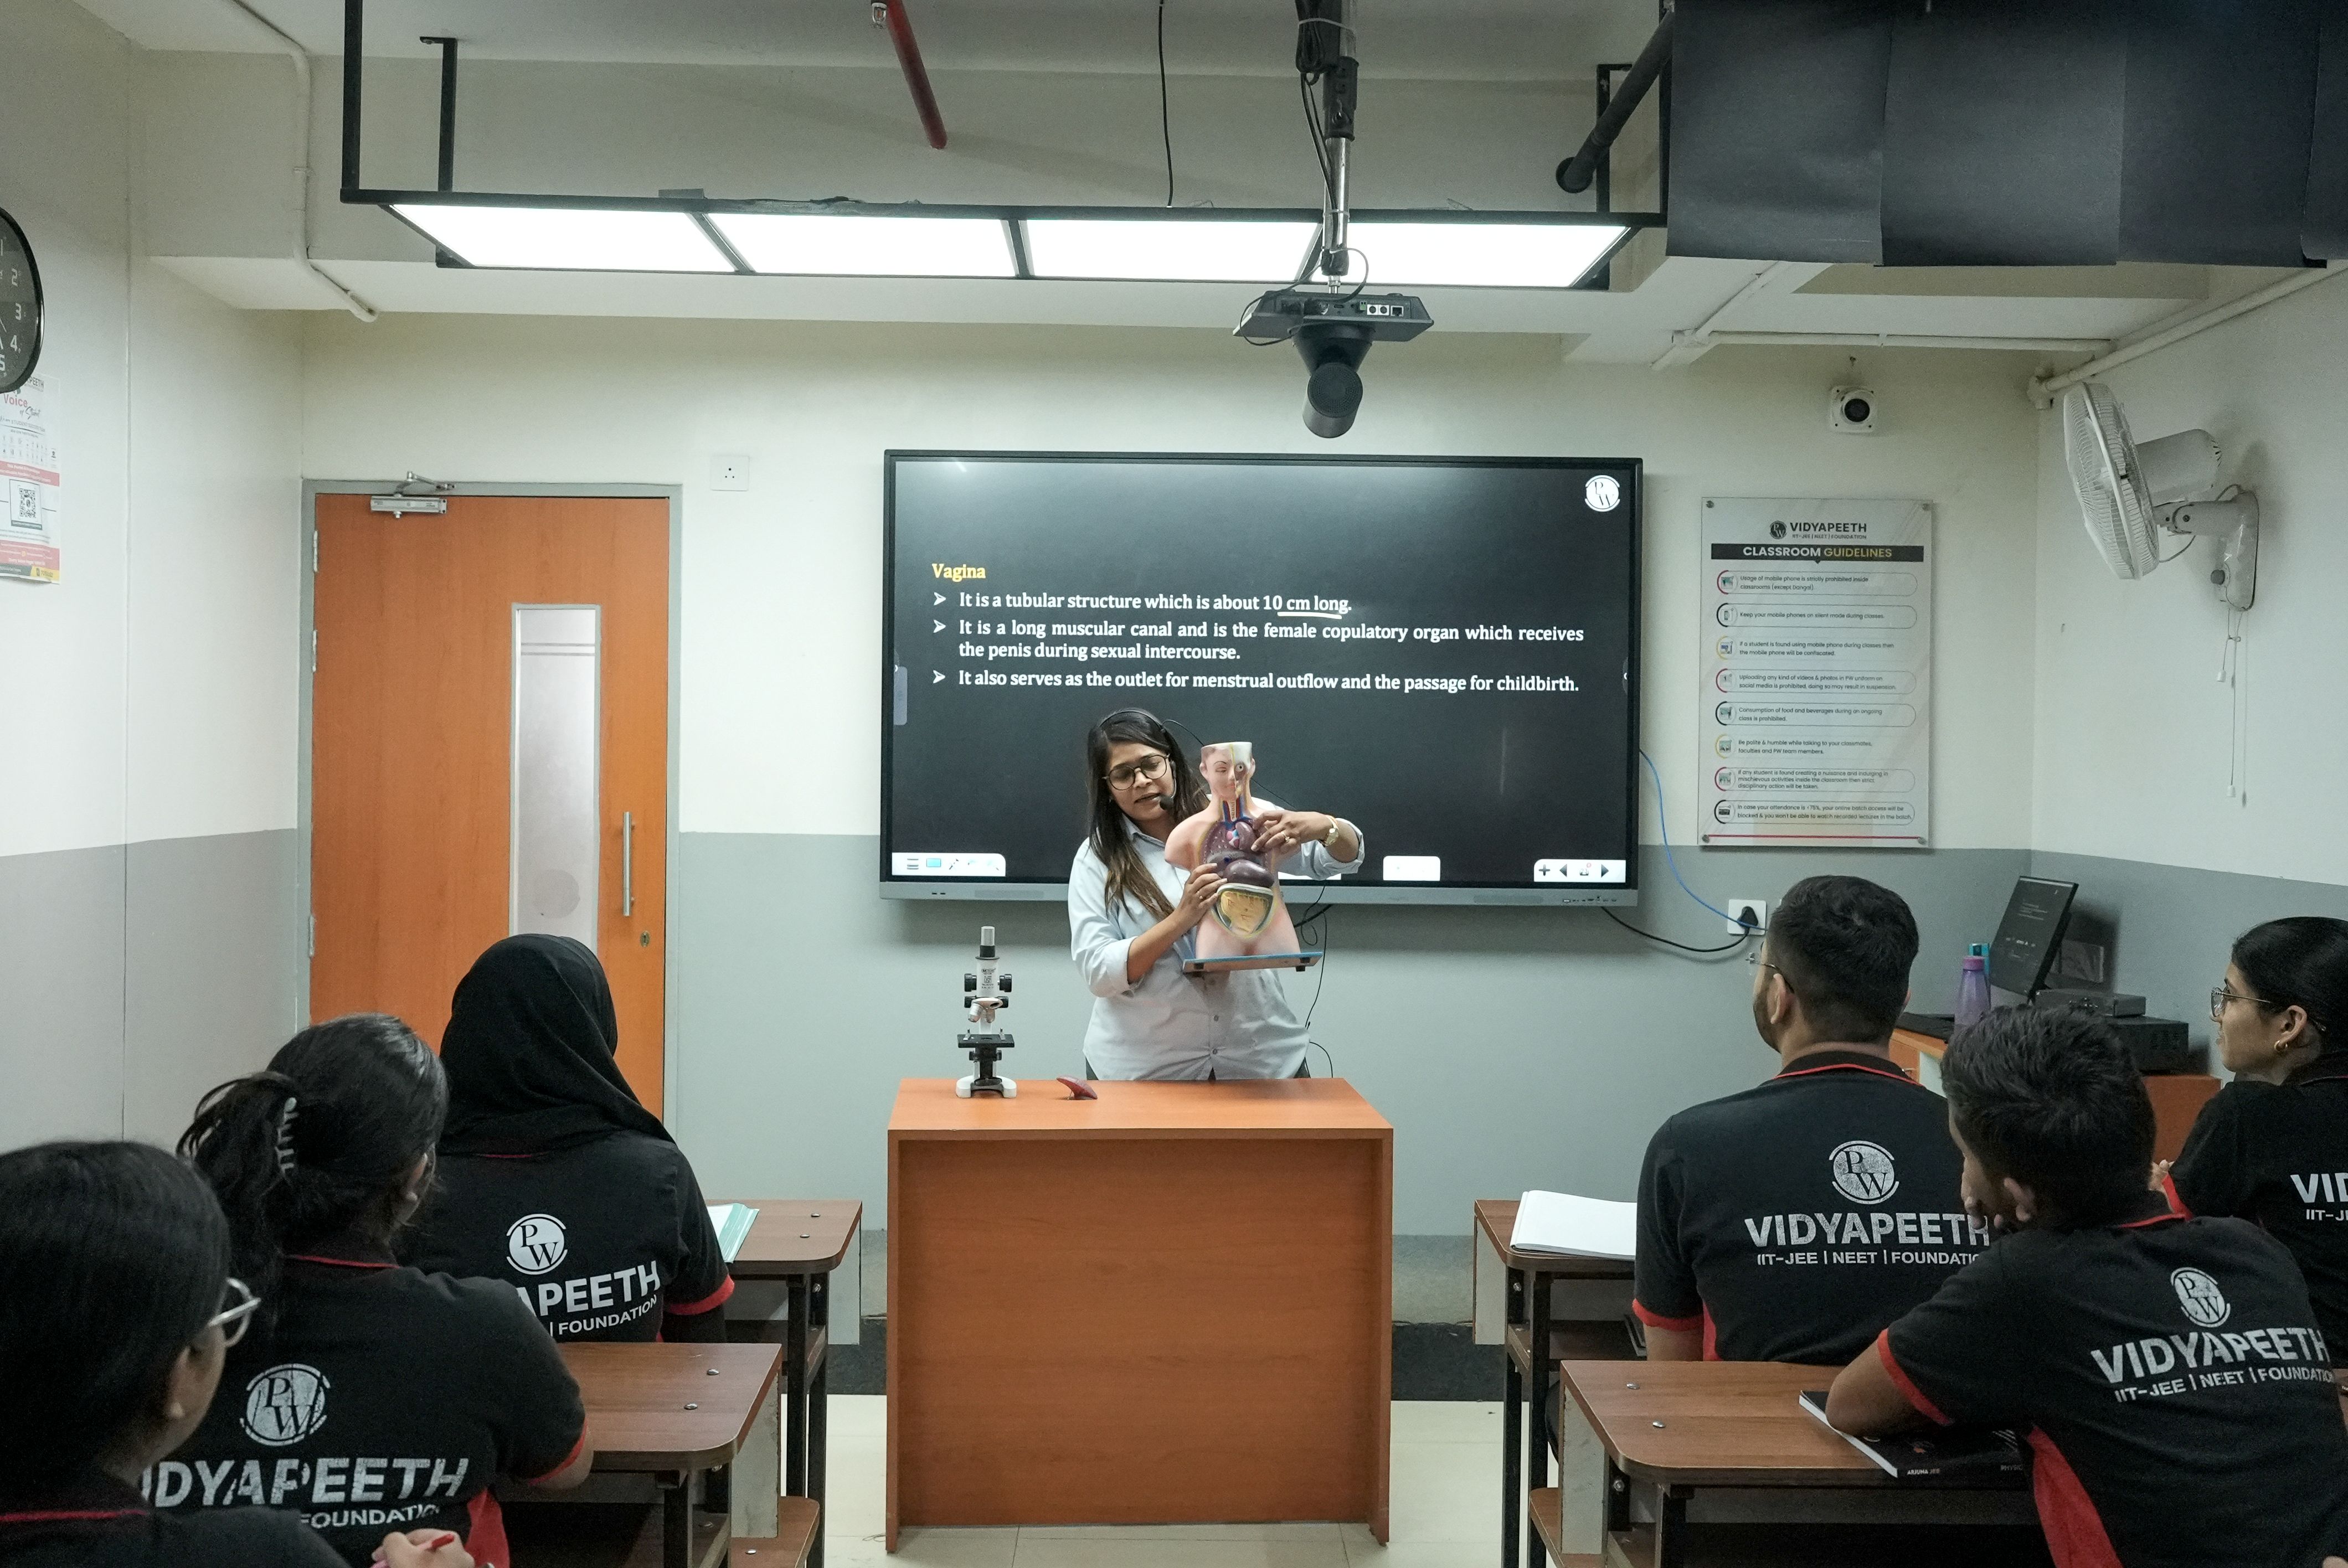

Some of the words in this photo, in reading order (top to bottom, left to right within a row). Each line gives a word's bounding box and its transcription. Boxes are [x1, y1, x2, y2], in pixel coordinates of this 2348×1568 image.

[12, 269, 18, 287] 2
[15, 303, 22, 321] 3
[10, 334, 18, 352] 4
[4, 394, 28, 408] Voice
[1789, 522, 1867, 533] VIDYAPEETH
[1743, 546, 1821, 556] CLASSROOM
[1824, 548, 1893, 558] GUIDELINES
[931, 563, 986, 582] Vagina
[960, 592, 973, 607] It
[975, 592, 990, 607] is
[992, 595, 1002, 607] a
[1005, 592, 1065, 608] tubular
[1067, 595, 1142, 609] structure
[1144, 593, 1193, 610] which
[1196, 595, 1210, 610] is
[1213, 594, 1260, 610] about
[1263, 595, 1283, 610] 10
[1286, 599, 1310, 611] cm
[1314, 595, 1352, 613] long.
[959, 619, 972, 635] It
[977, 620, 991, 635] is
[996, 623, 1006, 635] a
[1011, 619, 1047, 639] long
[1052, 620, 1126, 636] muscular
[1130, 621, 1172, 637] canal
[1177, 621, 1208, 637] and
[1213, 622, 1228, 637] is
[1232, 621, 1258, 638] the
[1264, 622, 1317, 638] female
[1322, 623, 1409, 642] copulatory
[1413, 627, 1460, 642] organ
[1464, 624, 1513, 641] which
[1518, 626, 1584, 642] receives
[959, 642, 985, 657] the
[988, 642, 1032, 661] penis
[1034, 643, 1088, 662] during
[1090, 643, 1141, 659] sexual
[1145, 643, 1241, 660] intercourse.
[959, 669, 972, 685] It
[974, 669, 1007, 685] also
[1010, 673, 1062, 687] serves
[1064, 674, 1083, 687] as
[1085, 670, 1113, 687] the
[1114, 671, 1163, 688] outlet
[1165, 671, 1190, 688] for
[1192, 672, 1274, 688] menstrual
[1276, 673, 1339, 689] outflow
[1341, 673, 1371, 689] and
[1374, 673, 1401, 690] the
[1404, 678, 1467, 694] passage
[1470, 674, 1494, 691] for
[1496, 675, 1579, 692] childbirth.
[2306, 1209, 2348, 1221] IIT-J
[1744, 1213, 1990, 1247] VIDYAPEETH
[1757, 1252, 1818, 1265] IIT-JEE
[1832, 1252, 1877, 1263] NEET
[559, 1294, 657, 1335] FOUNDATION
[2090, 1328, 2330, 1384] VIDYAPEETH
[2114, 1379, 2186, 1402] IIT-JEE
[2200, 1370, 2244, 1388] NEET
[2257, 1367, 2334, 1383] FOUNDATIO
